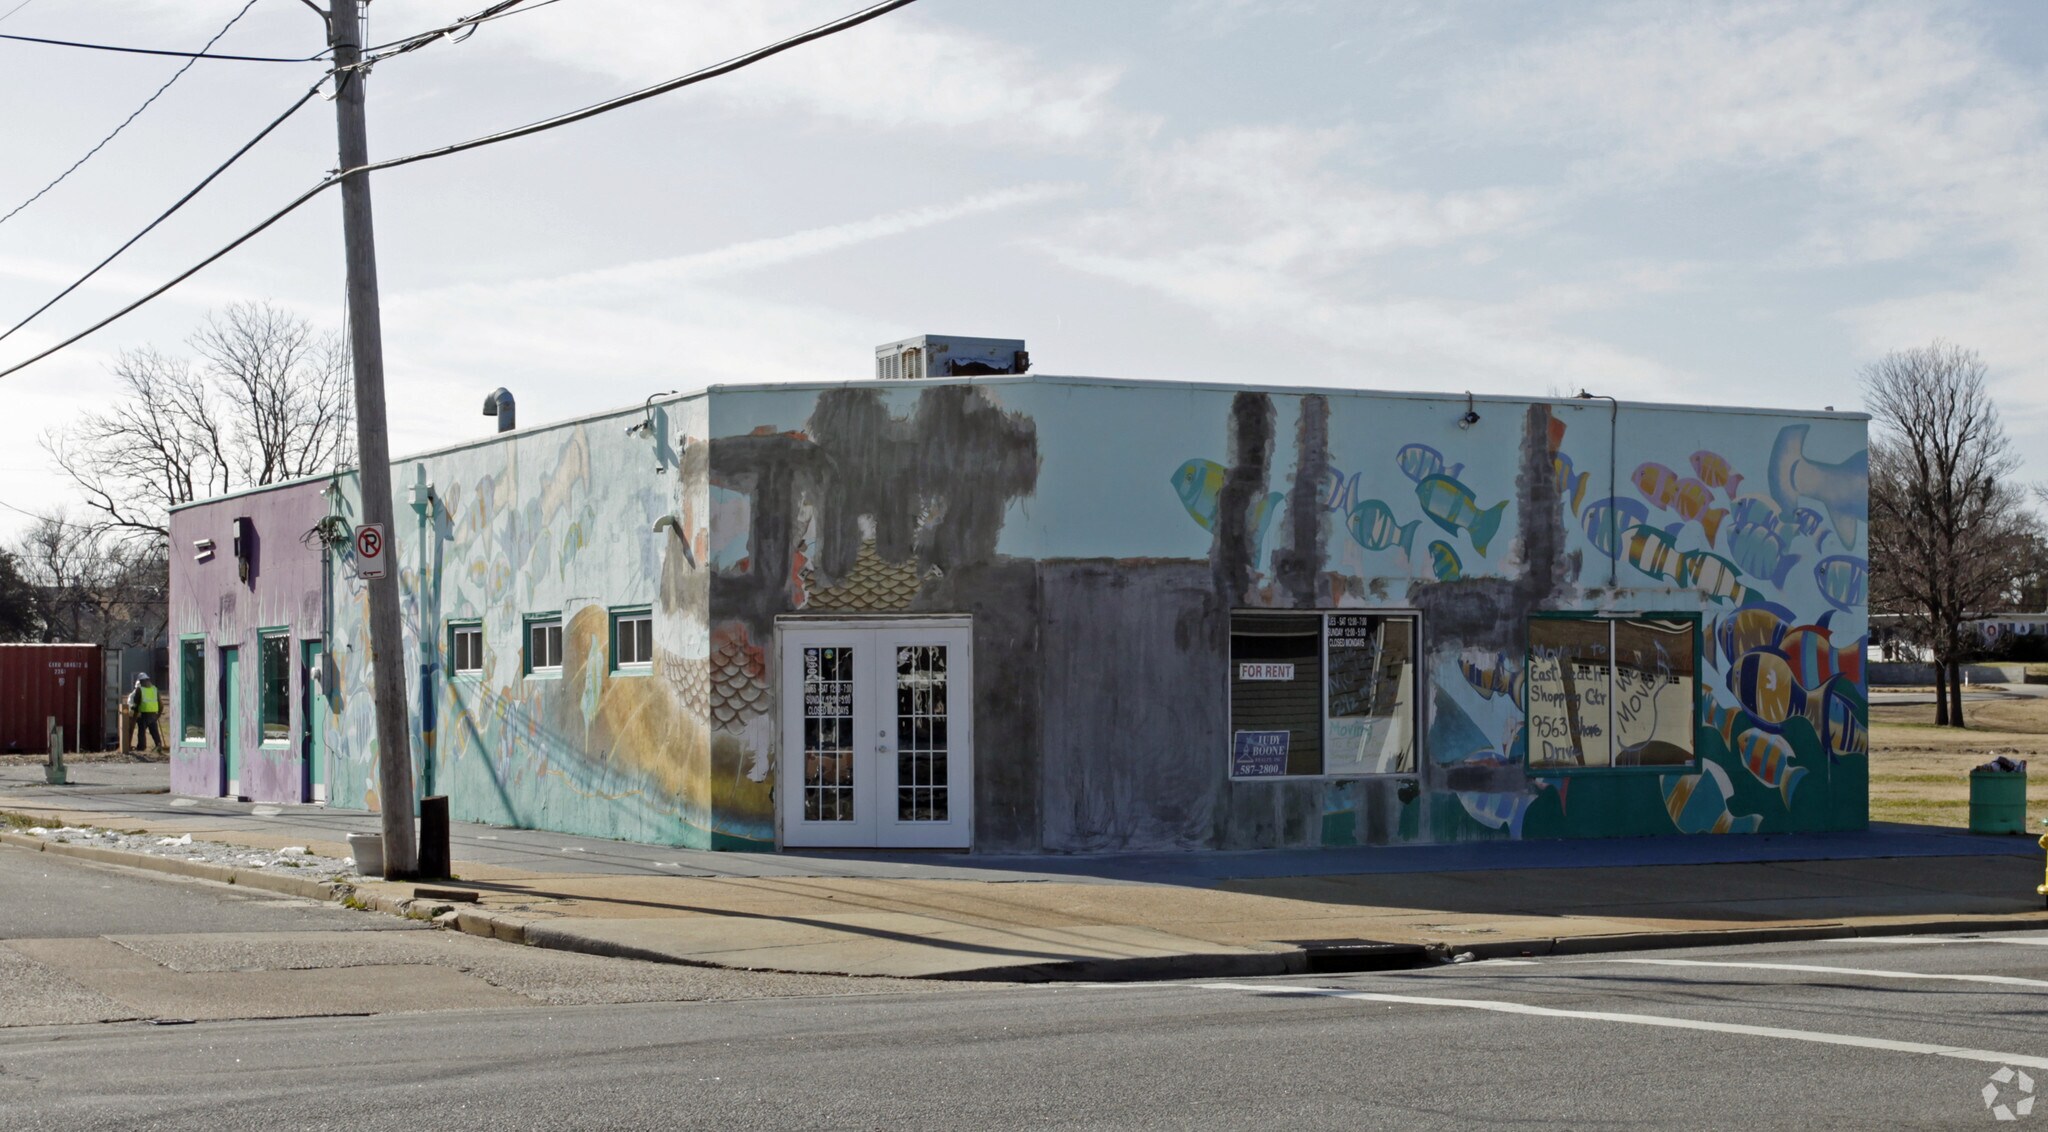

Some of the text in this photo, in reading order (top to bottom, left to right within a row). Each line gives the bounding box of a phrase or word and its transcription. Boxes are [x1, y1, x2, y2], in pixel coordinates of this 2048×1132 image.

[365, 533, 377, 553] P
[1329, 638, 1365, 648] CLOSED MONDAYS
[1242, 665, 1291, 678] FOR RENT
[1531, 664, 1602, 682] East each
[1585, 688, 1607, 706] Ctr
[808, 706, 827, 716] CLOSED
[1532, 715, 1603, 738] 9563 hore
[1252, 746, 1285, 756] BOONE
[1240, 764, 1279, 775] 587-2800
